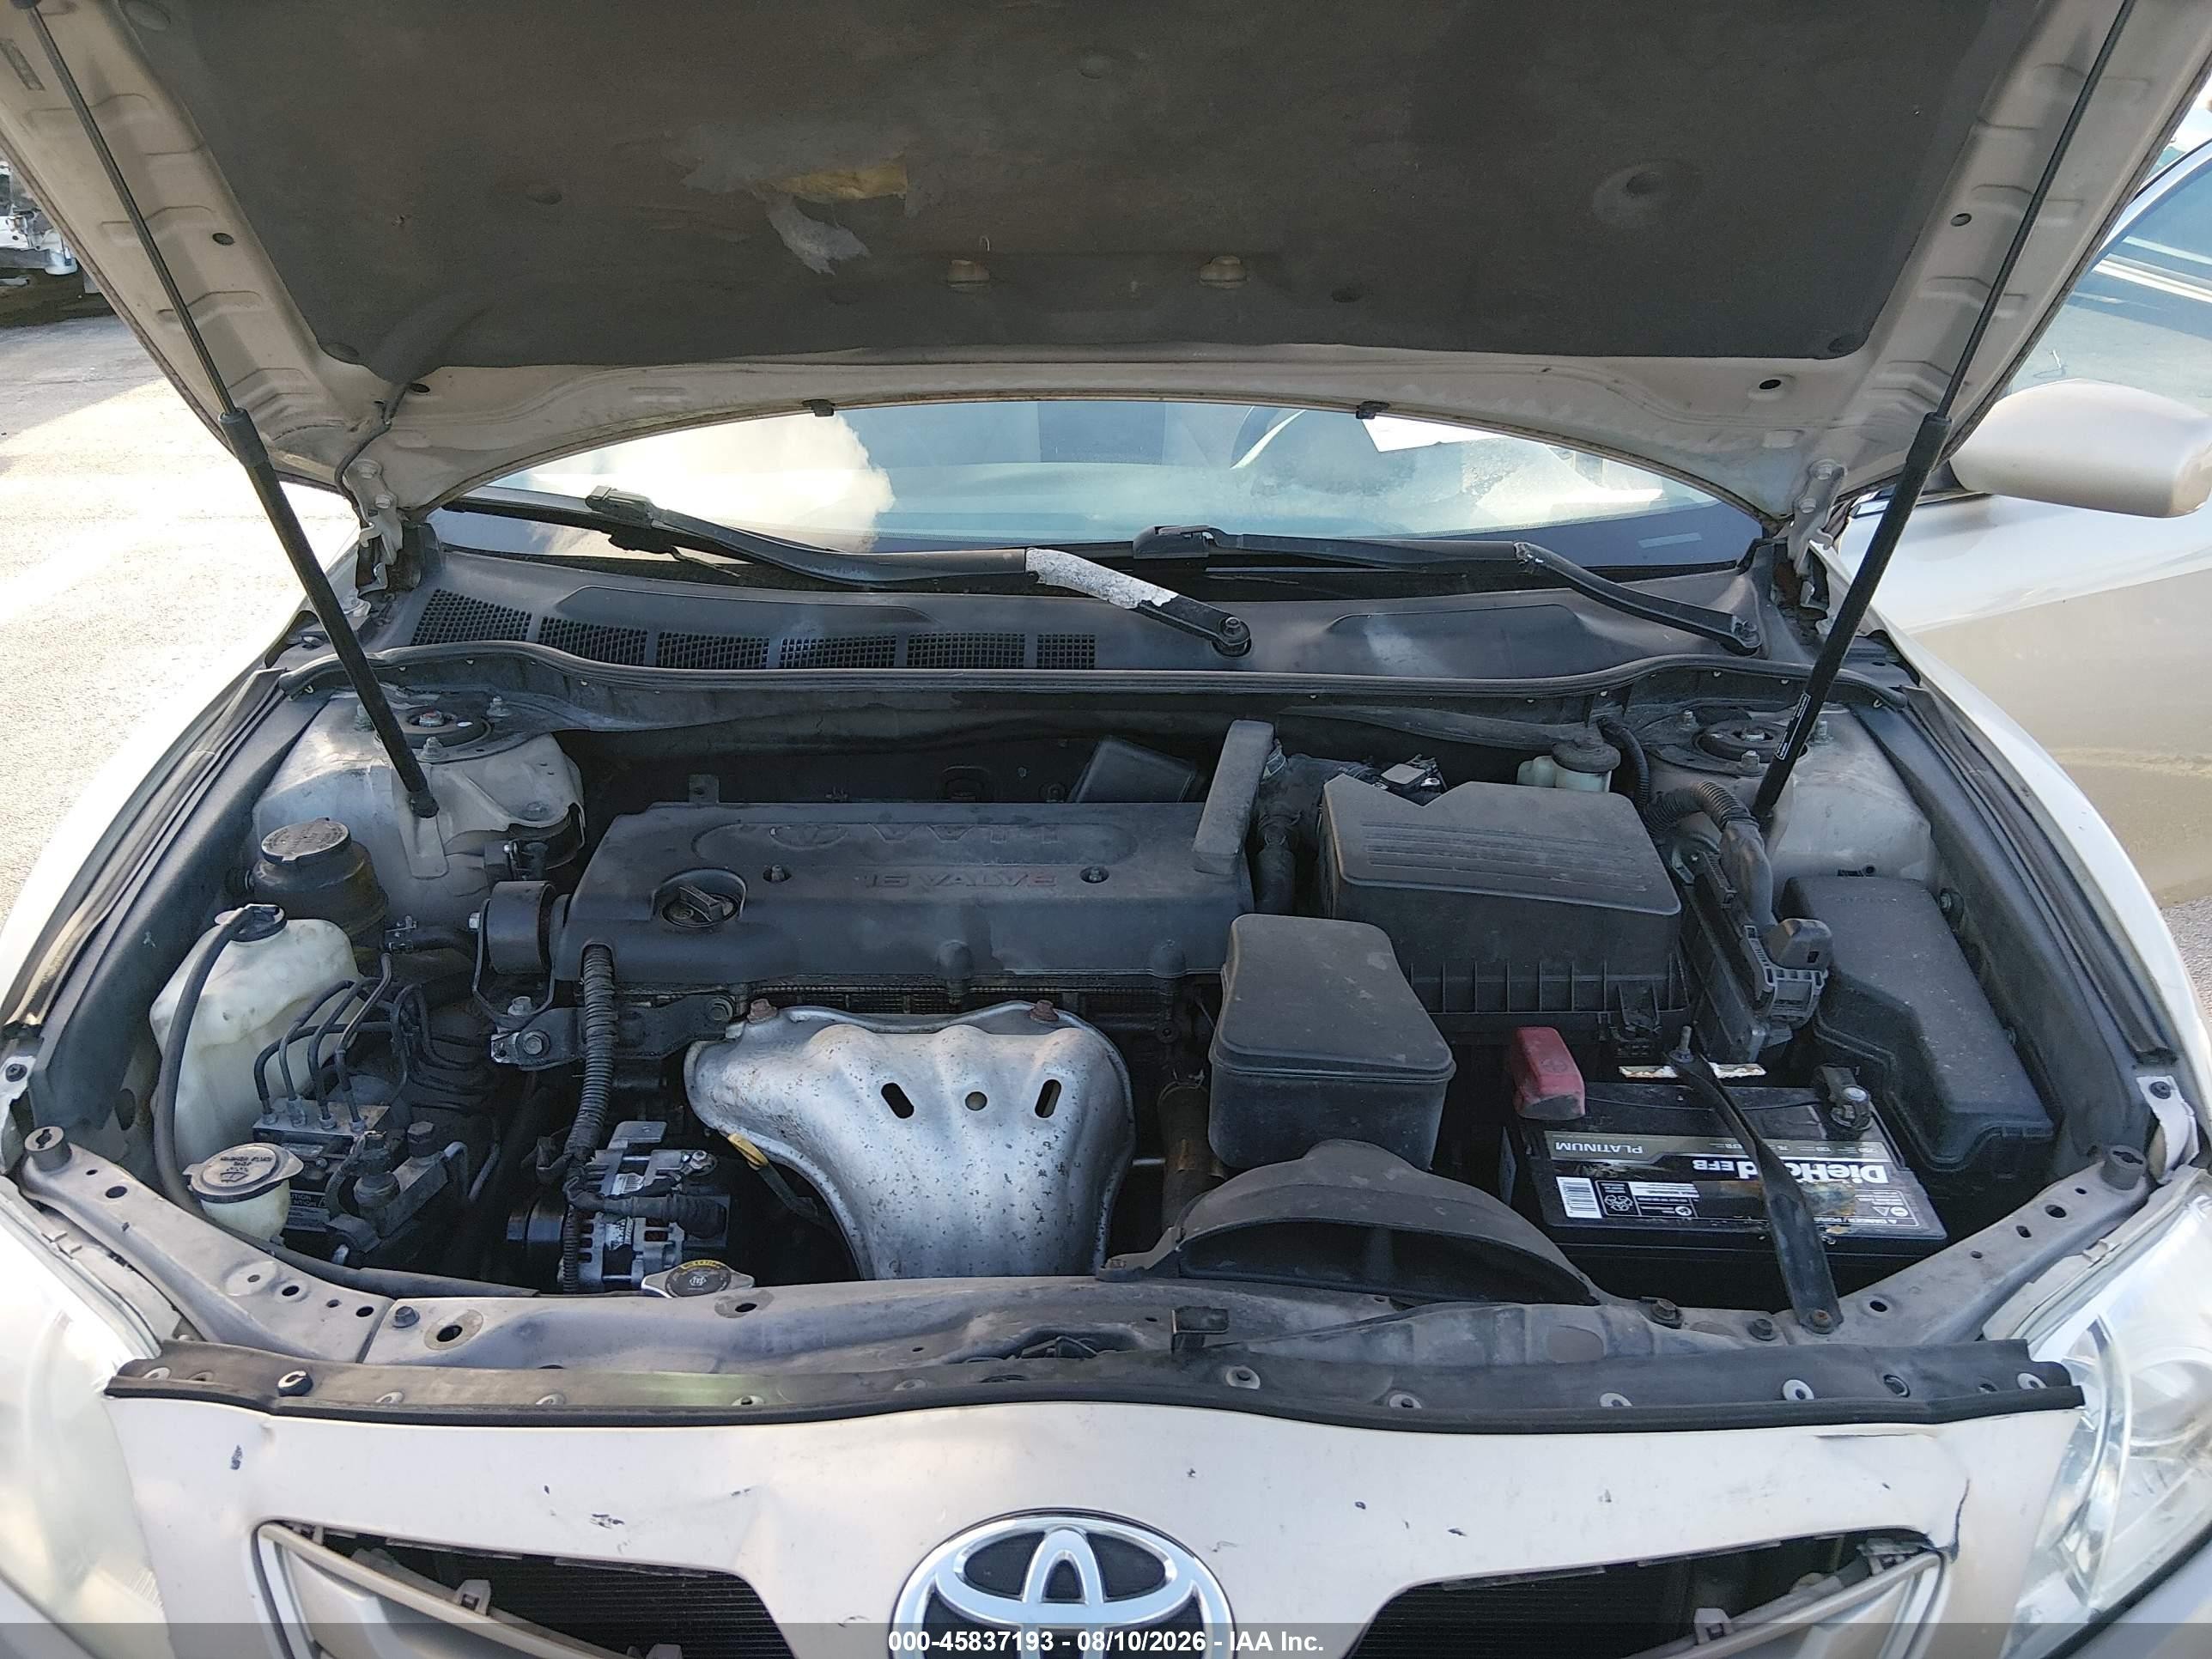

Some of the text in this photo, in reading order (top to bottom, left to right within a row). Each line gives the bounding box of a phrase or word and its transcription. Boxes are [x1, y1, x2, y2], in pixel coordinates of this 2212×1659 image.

[1555, 1141, 1644, 1154] PLATINUM
[1692, 1159, 1889, 1184] DieHad EFB
